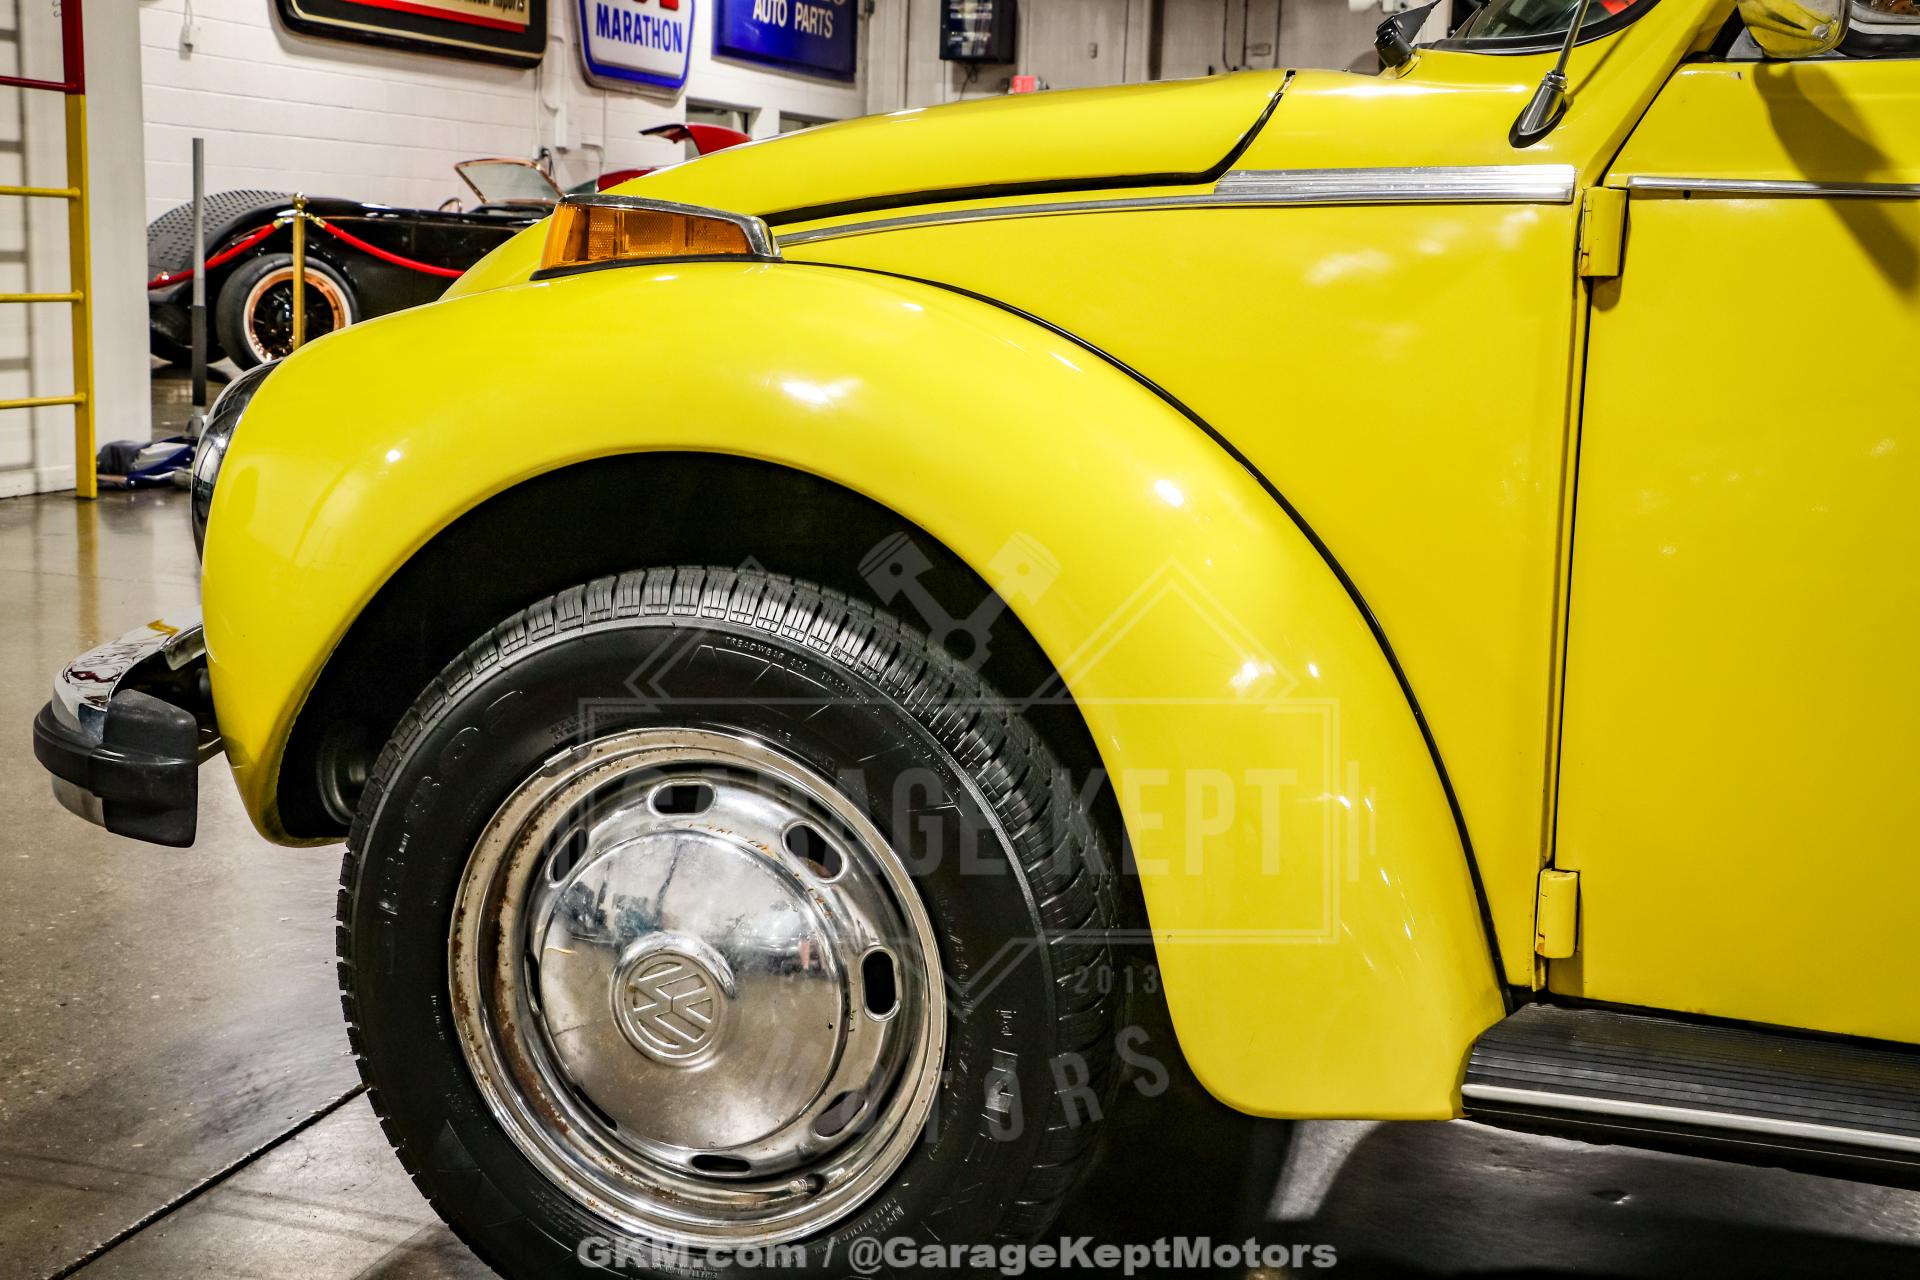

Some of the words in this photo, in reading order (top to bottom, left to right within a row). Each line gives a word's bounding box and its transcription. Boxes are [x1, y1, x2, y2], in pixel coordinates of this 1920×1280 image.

[596, 8, 683, 53] MARATHON
[753, 0, 788, 27] AUTO
[795, 5, 833, 38] PARTS
